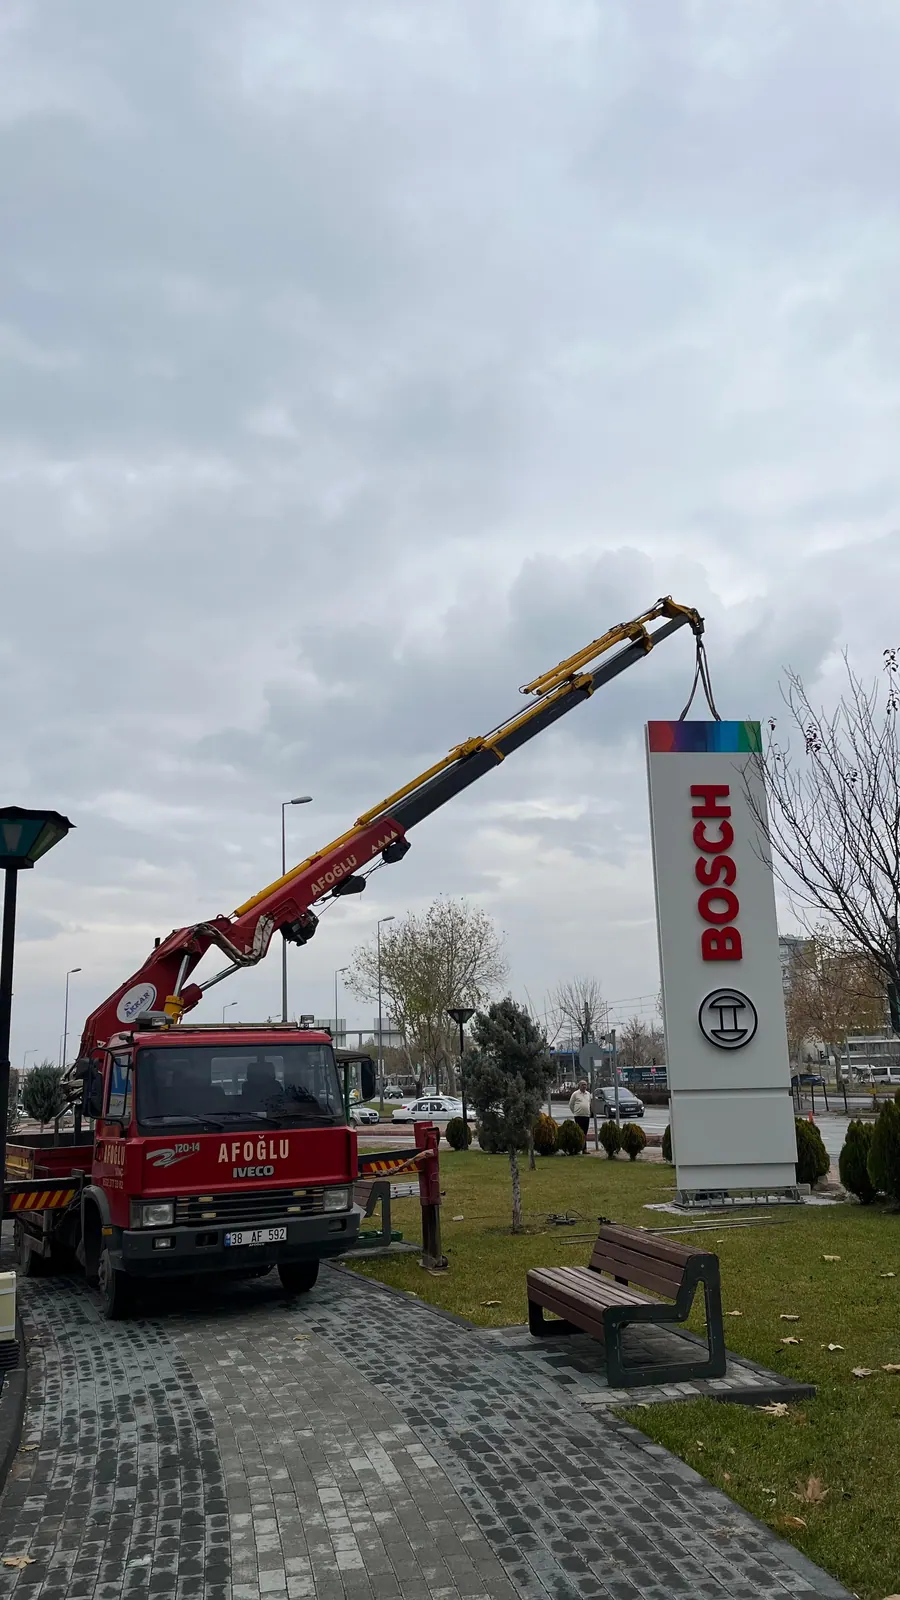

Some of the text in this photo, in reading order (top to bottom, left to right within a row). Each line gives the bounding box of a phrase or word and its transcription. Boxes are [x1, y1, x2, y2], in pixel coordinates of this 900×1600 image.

[310, 854, 358, 896] AFOĞLU
[690, 784, 743, 961] BOSCH
[174, 1142, 200, 1154] 120-14
[217, 1135, 290, 1163] AFOĞLU
[232, 1165, 275, 1178] IVECO
[231, 1228, 285, 1244] 38 AF 592
